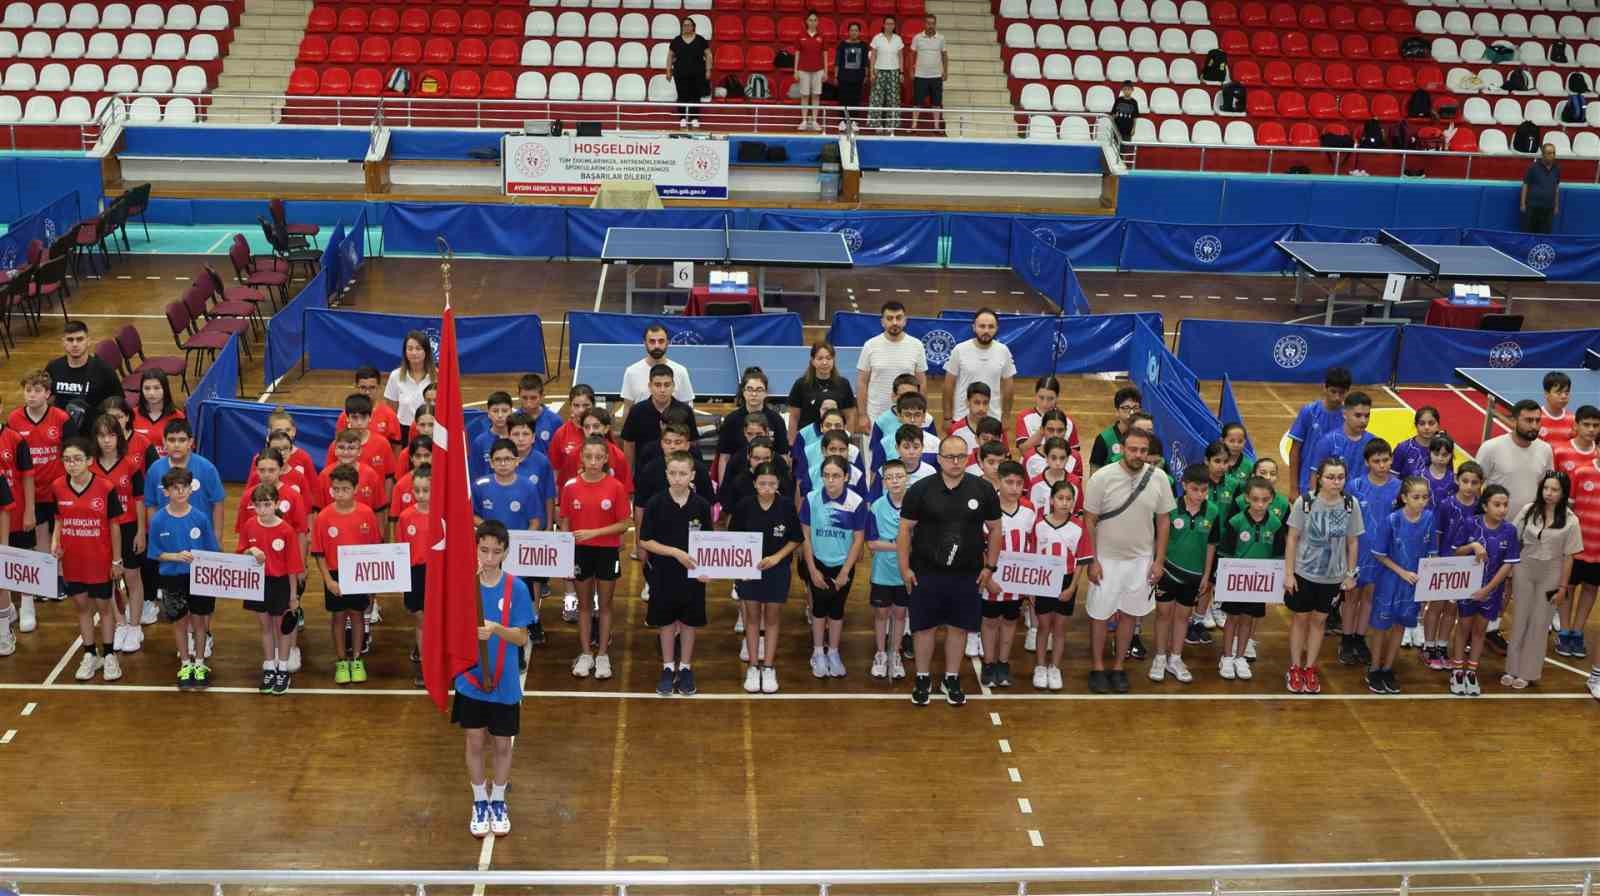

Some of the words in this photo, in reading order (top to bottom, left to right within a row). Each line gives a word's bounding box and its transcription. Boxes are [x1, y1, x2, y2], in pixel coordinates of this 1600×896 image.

[574, 143, 661, 156] HOŞGELDİNİZ
[679, 265, 688, 281] 6
[56, 380, 90, 393] mavi
[518, 543, 558, 567] İZMİR
[697, 545, 753, 568] MANİSA
[5, 560, 40, 585] UŞAK
[194, 565, 260, 590] ESKİŞEHİR
[355, 560, 396, 582] AYDIN
[1002, 563, 1052, 587] BİLECİK
[1226, 571, 1276, 593] DENİZLİ
[1428, 571, 1471, 591] AFYON
